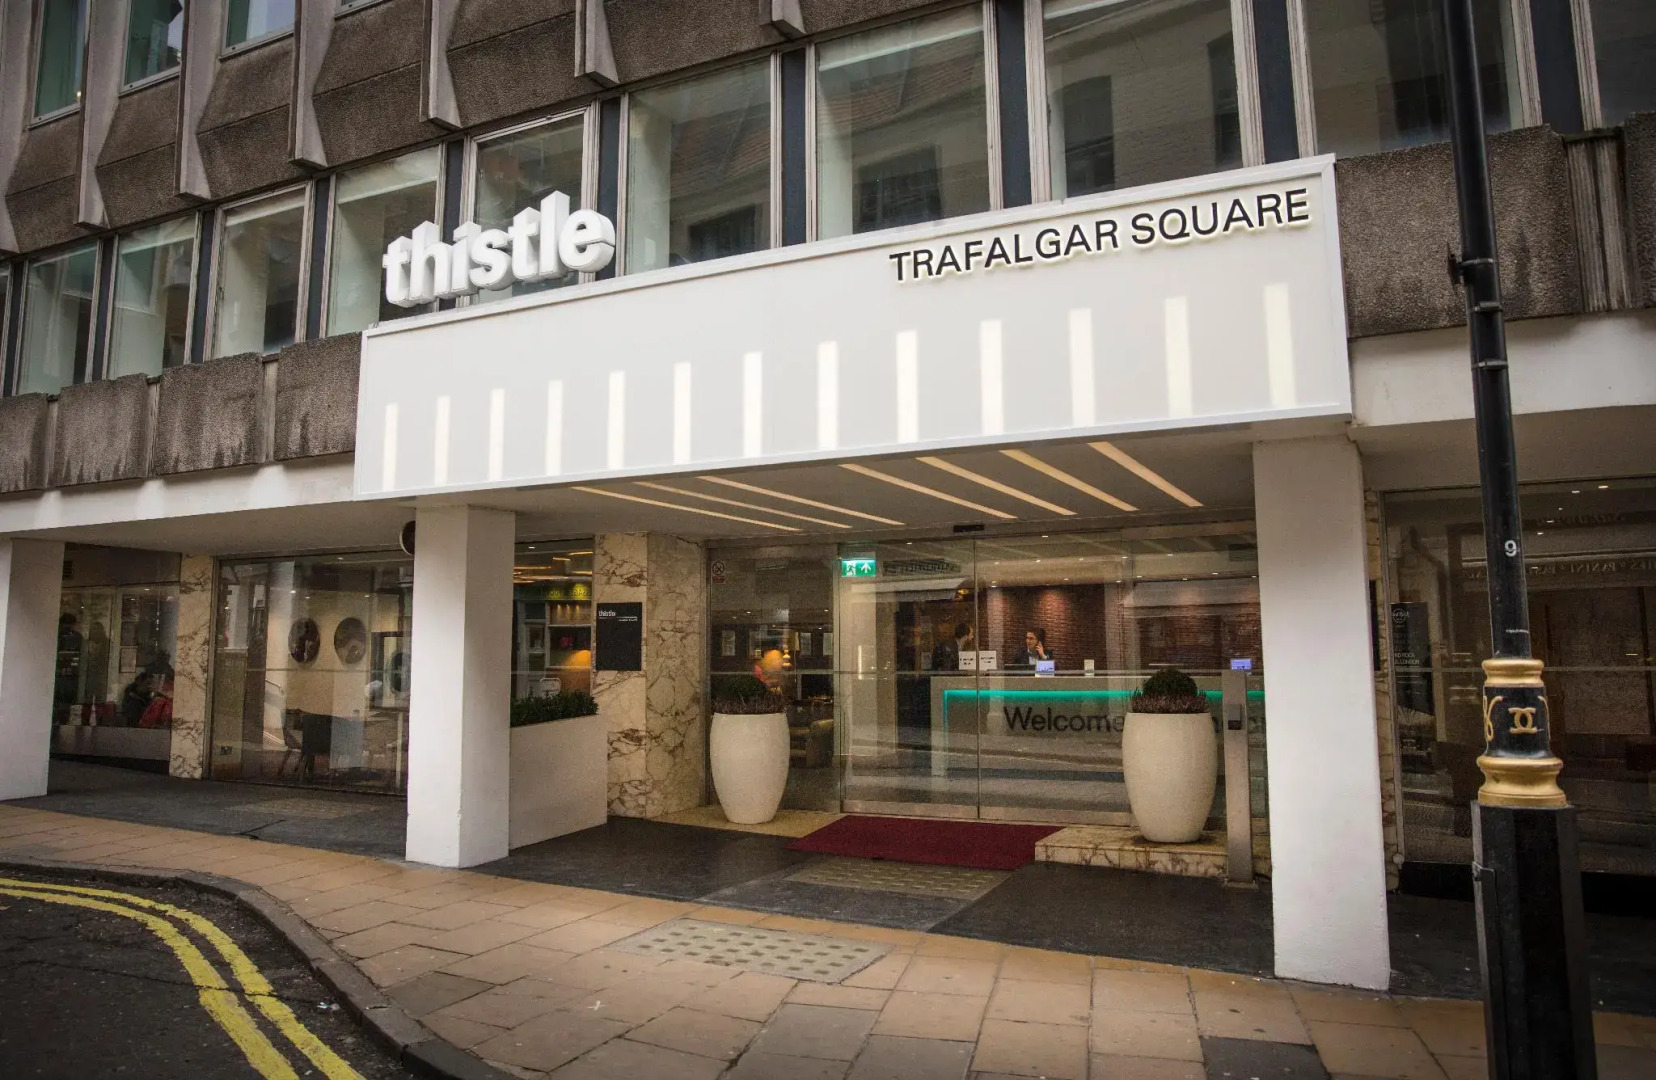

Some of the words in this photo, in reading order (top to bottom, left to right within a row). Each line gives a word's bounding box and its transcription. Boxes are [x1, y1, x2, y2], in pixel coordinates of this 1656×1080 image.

[382, 189, 616, 308] thistle
[889, 220, 1119, 281] TRAFALGAR
[1131, 188, 1310, 245] SQUARE
[1003, 706, 1125, 732] Welcome
